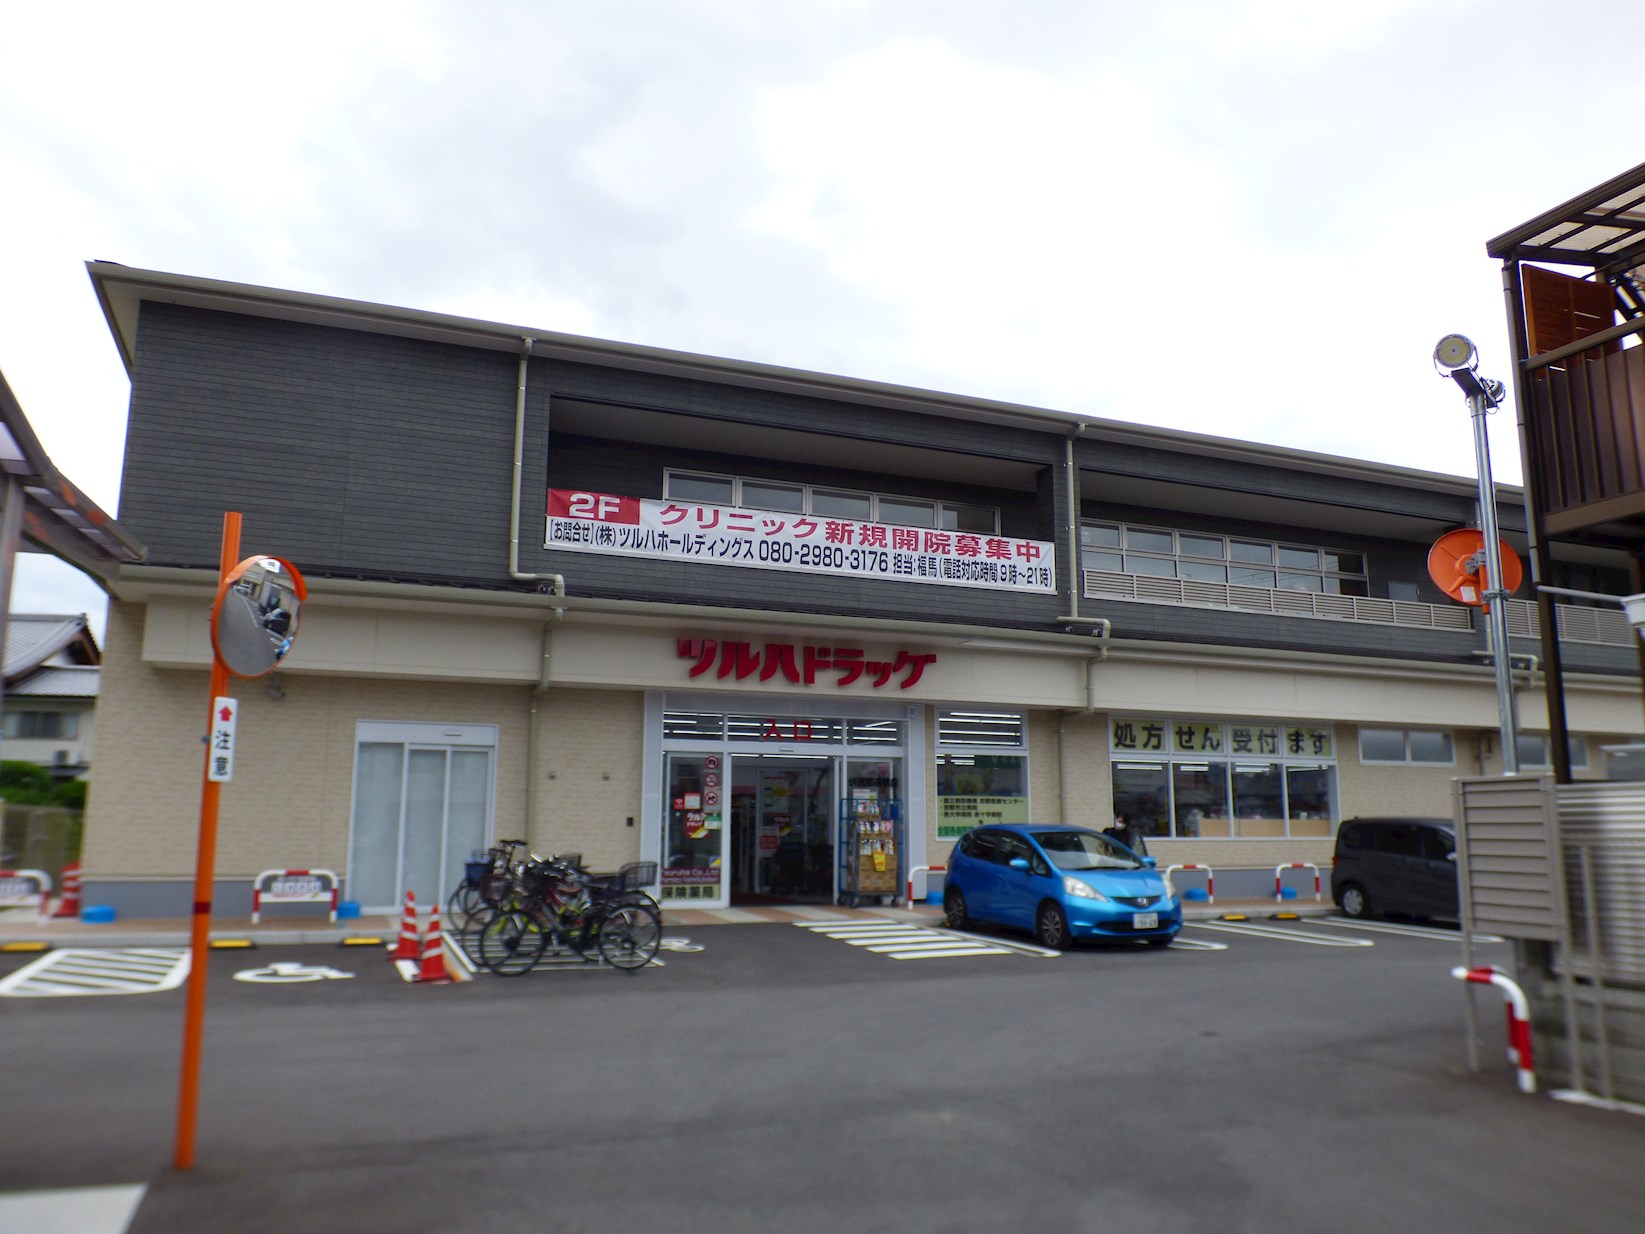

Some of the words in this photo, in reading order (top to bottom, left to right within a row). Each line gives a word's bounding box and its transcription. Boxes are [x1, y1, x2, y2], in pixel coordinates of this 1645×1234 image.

[569, 493, 621, 520] 2F
[659, 504, 1041, 563] クリニック新規開院募集中
[763, 719, 812, 740] 入口
